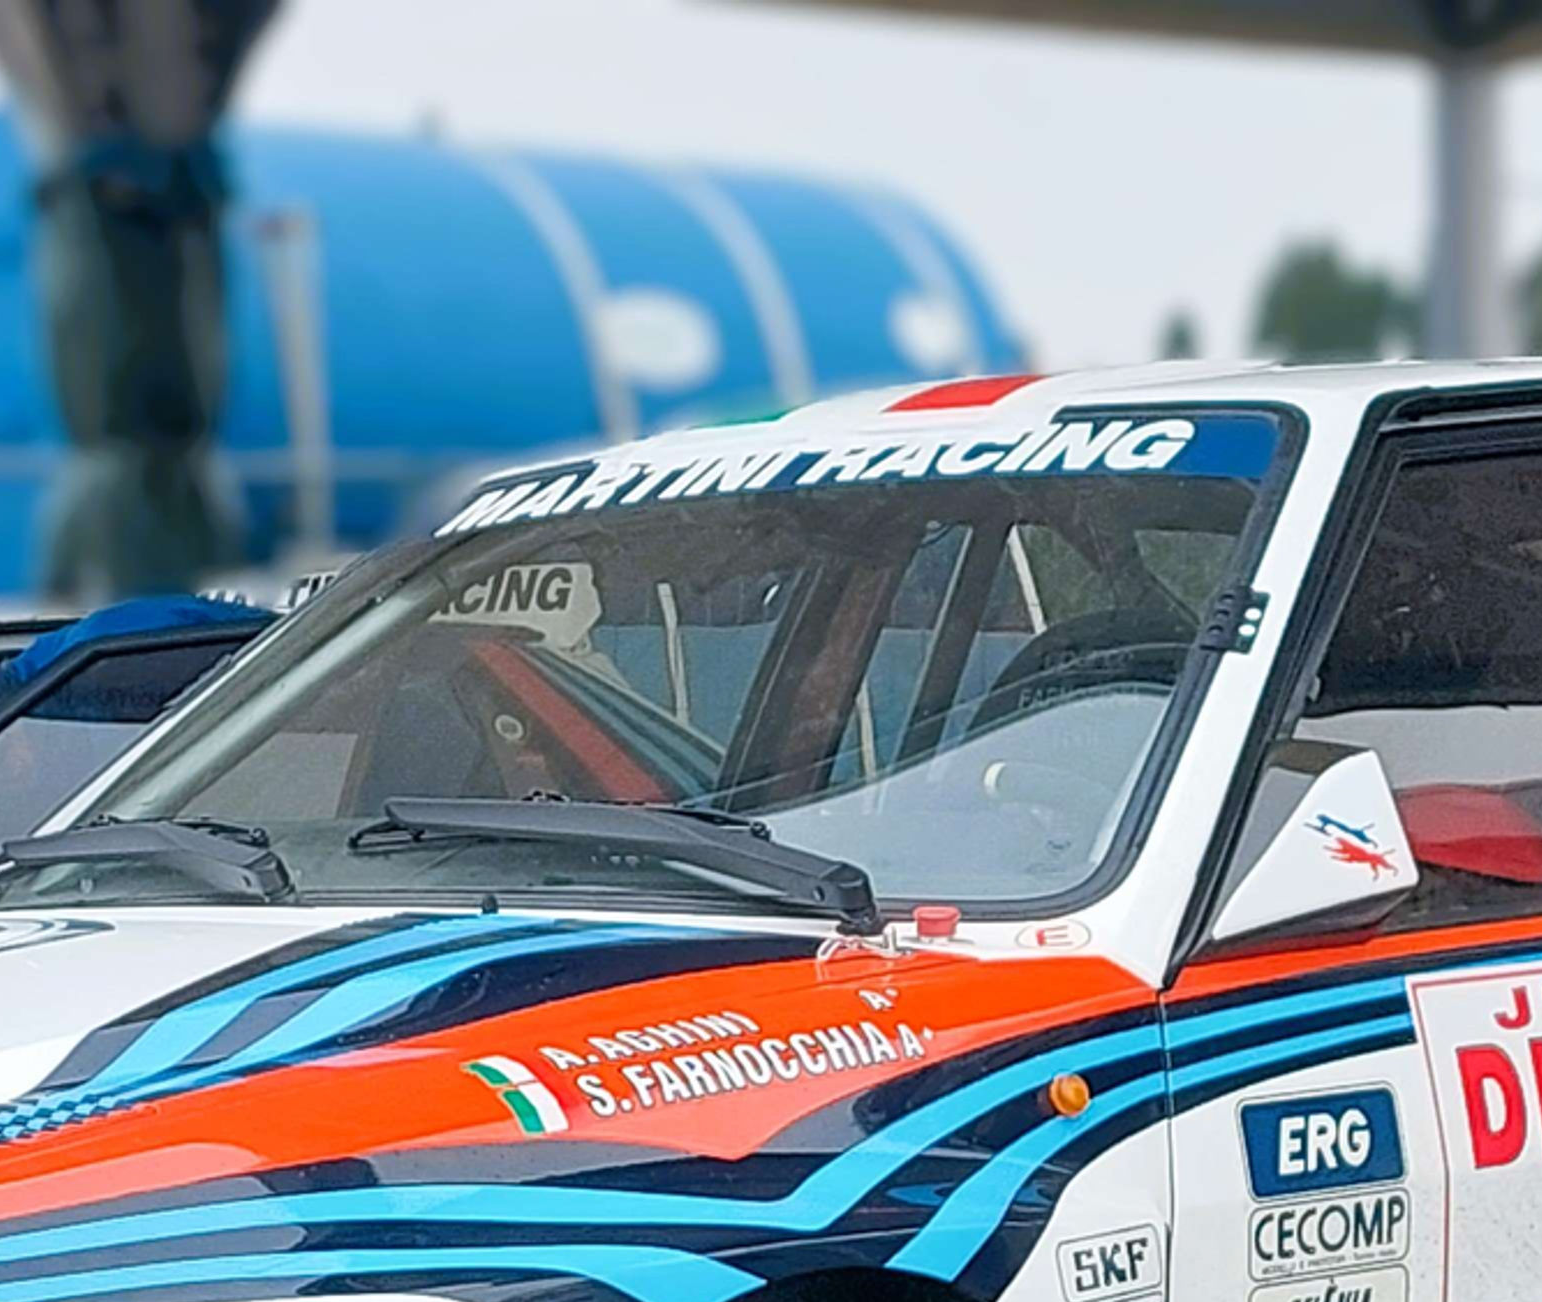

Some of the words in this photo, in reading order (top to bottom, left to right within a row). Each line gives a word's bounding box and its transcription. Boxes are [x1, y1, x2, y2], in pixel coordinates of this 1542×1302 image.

[434, 443, 807, 537] MARTINI
[798, 420, 1196, 485] RACING
[1277, 1108, 1372, 1177] ERG
[1253, 1195, 1406, 1262] CECOMP
[1072, 1237, 1149, 1293] SKF
